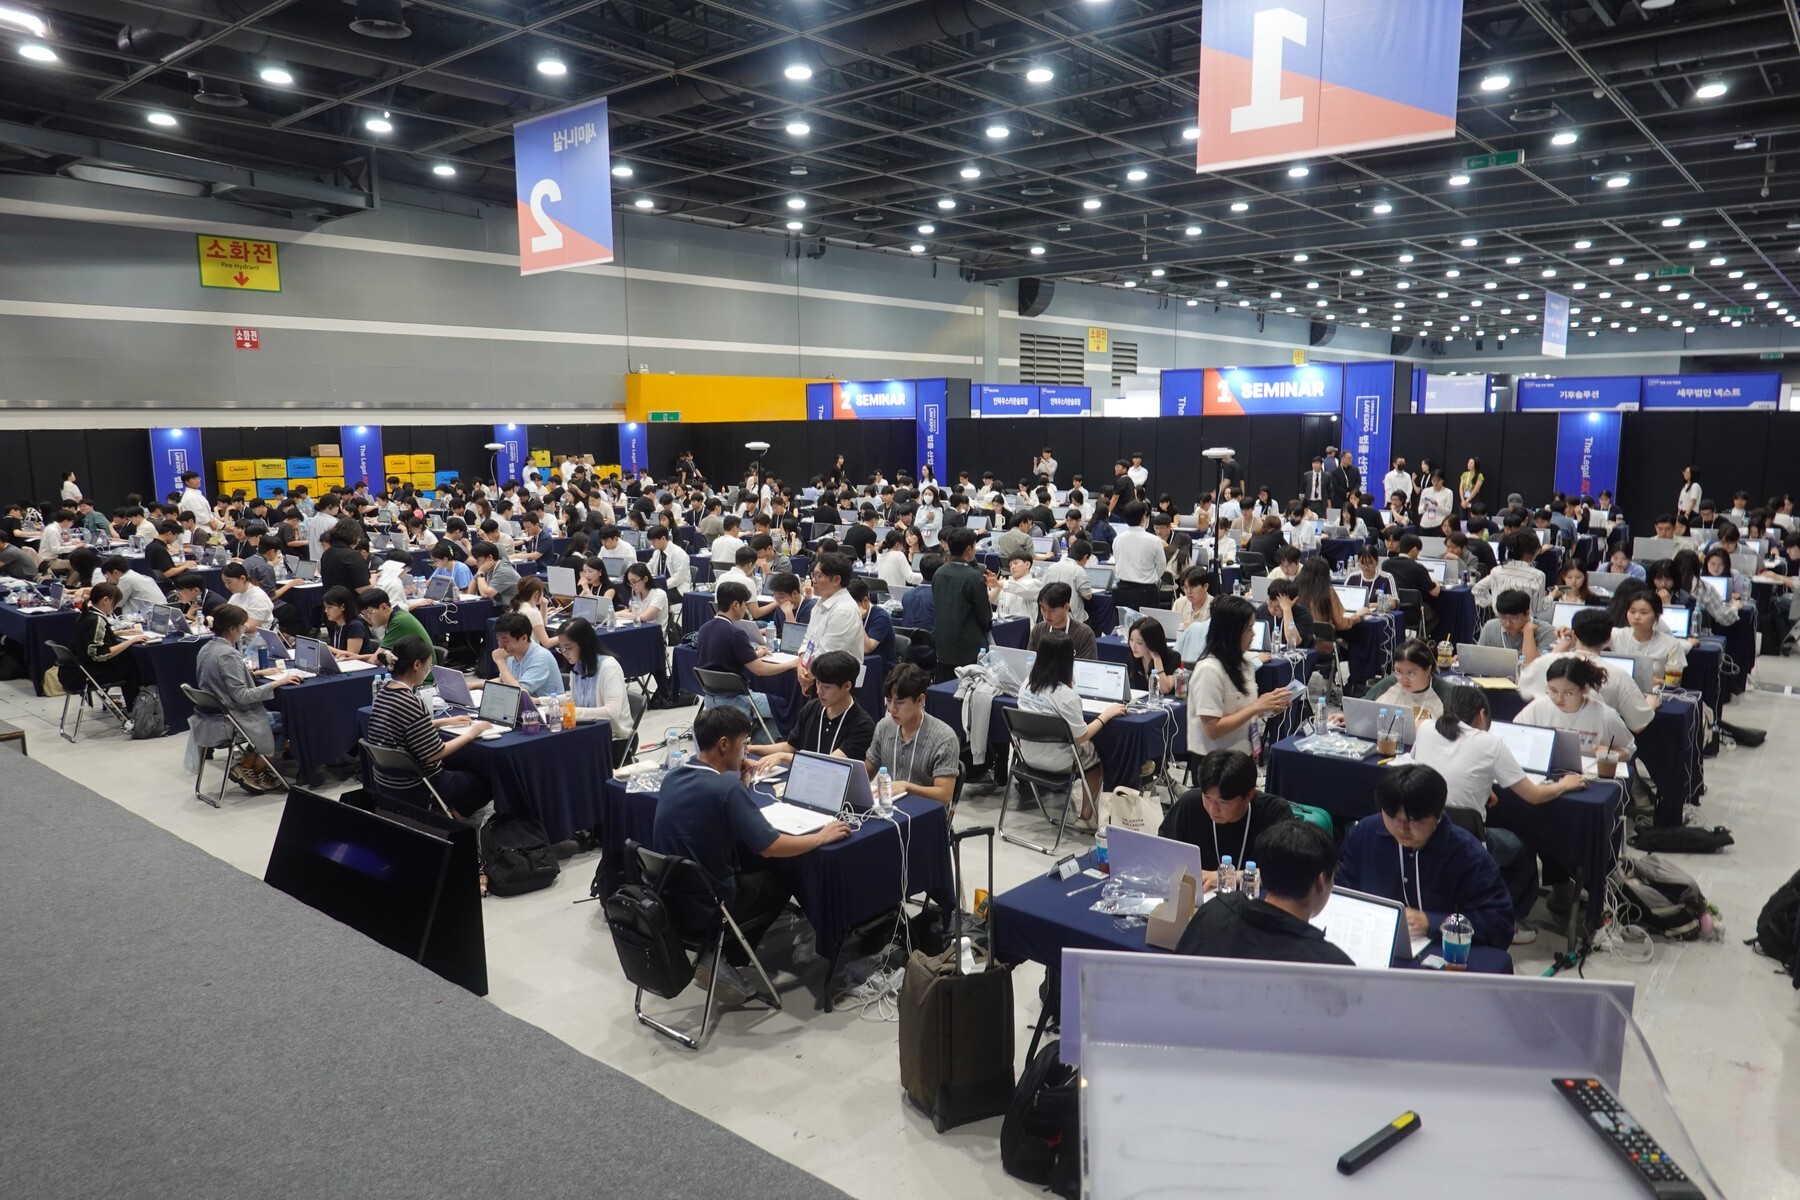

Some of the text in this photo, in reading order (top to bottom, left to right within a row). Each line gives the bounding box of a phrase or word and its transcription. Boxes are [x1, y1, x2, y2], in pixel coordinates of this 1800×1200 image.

[206, 239, 272, 264] 소화전
[221, 261, 260, 271] Fire Hydrant
[236, 330, 258, 341] 소화전
[841, 391, 906, 410] 2 SEMINAR
[1217, 380, 1325, 403] 1 SEMINAR
[1559, 390, 1600, 399] 기후솔루션
[1178, 396, 1187, 416] The
[1359, 435, 1370, 454] 법률
[1584, 436, 1593, 453] The
[360, 458, 368, 475] Legal
[1358, 455, 1369, 474] 산업
[1581, 455, 1592, 478] Legal
